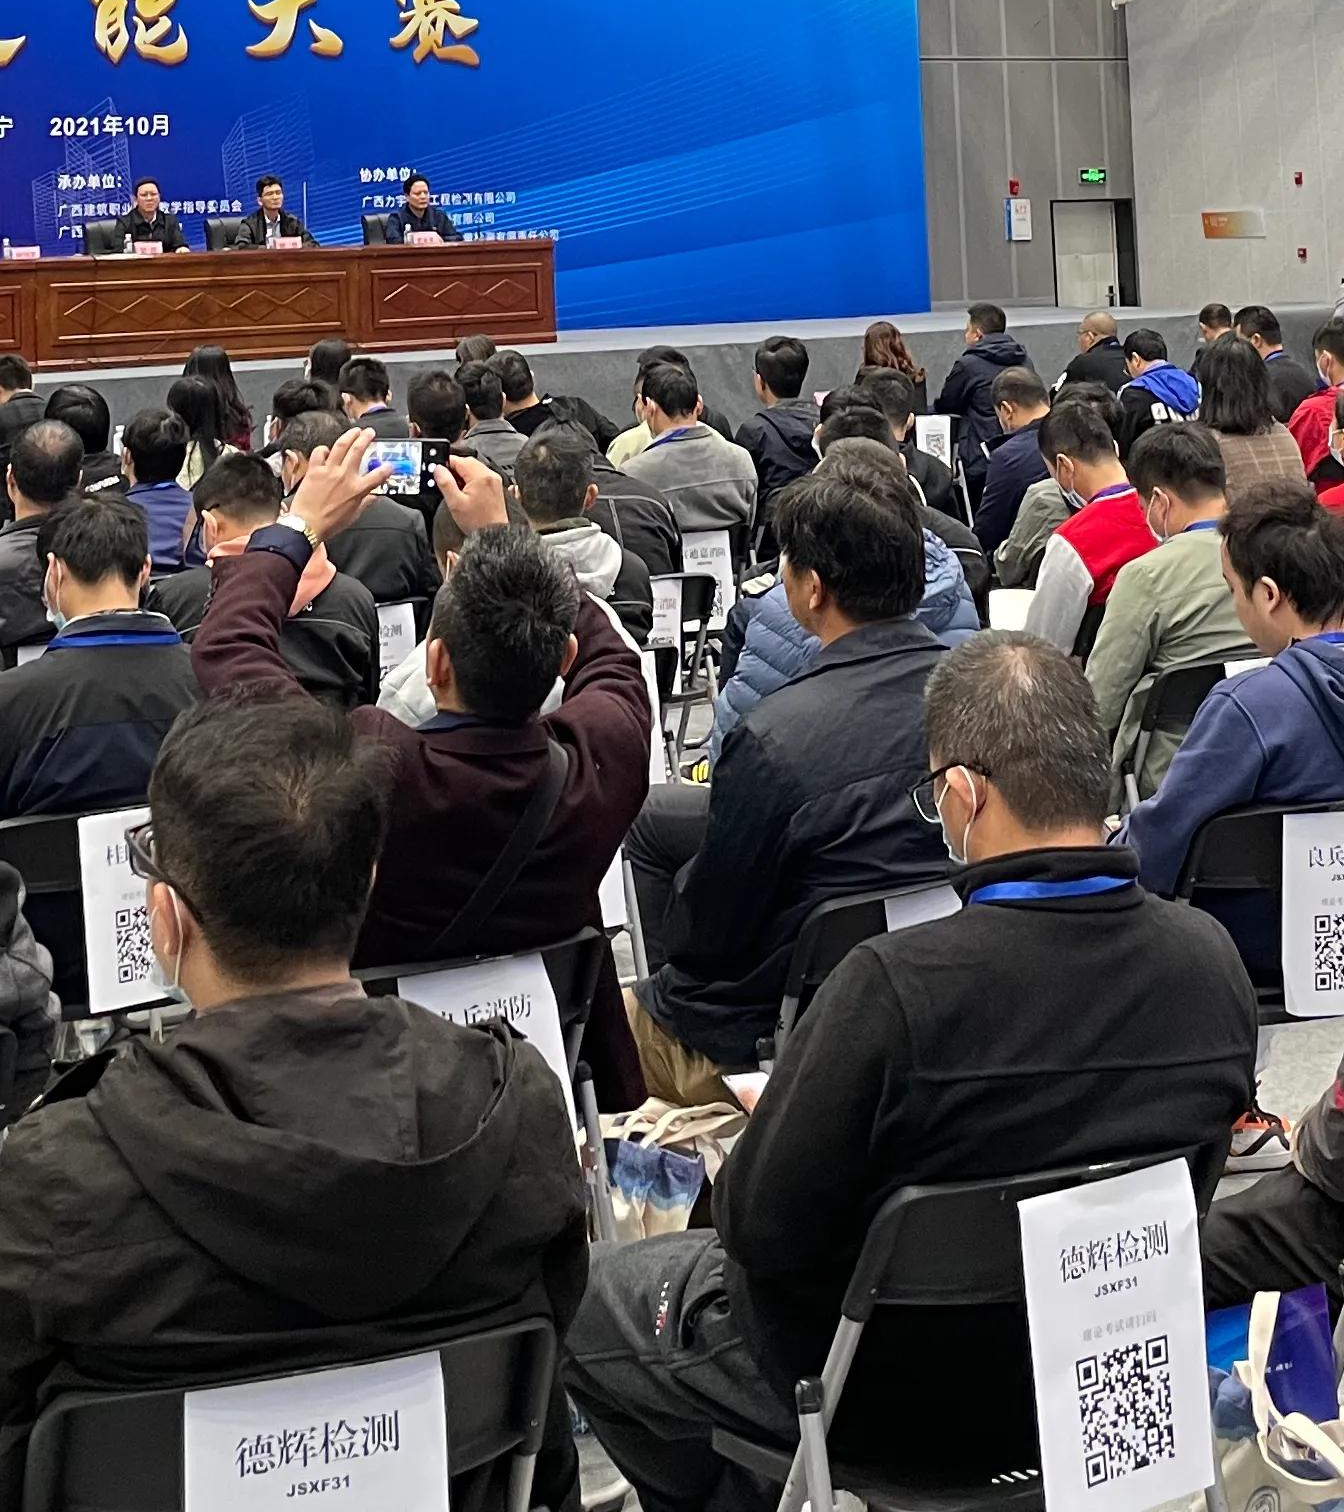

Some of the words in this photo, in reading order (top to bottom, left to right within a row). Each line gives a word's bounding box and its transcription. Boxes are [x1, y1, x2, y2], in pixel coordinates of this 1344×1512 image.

[49, 113, 171, 138] 2021年10月
[447, 211, 496, 225] 有限公司
[1059, 1219, 1169, 1283] 德辉检测
[1094, 1275, 1139, 1298] JSXF31
[234, 1409, 401, 1478] 德辉检测
[286, 1474, 351, 1498] JSXF31
